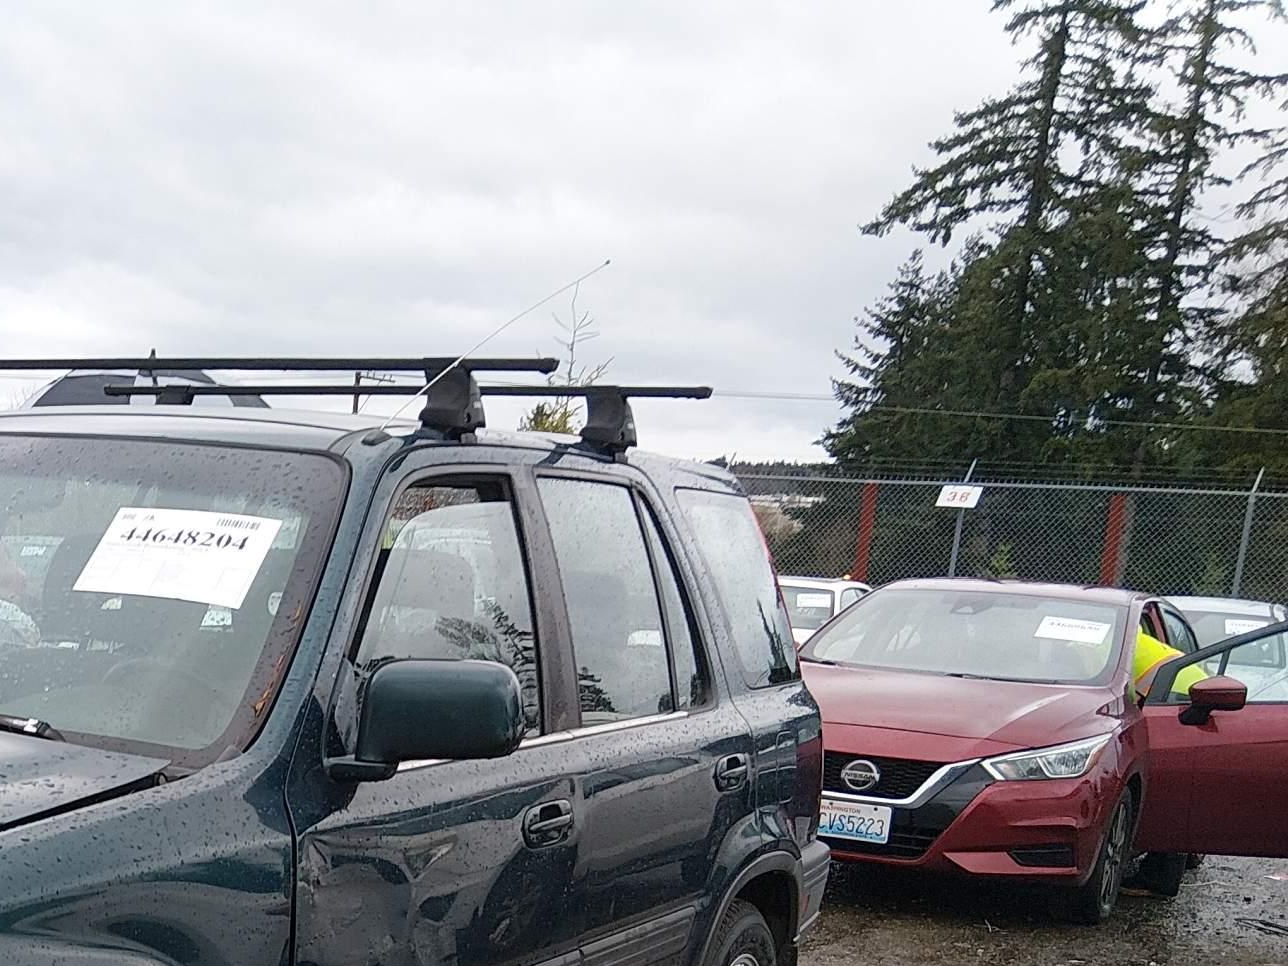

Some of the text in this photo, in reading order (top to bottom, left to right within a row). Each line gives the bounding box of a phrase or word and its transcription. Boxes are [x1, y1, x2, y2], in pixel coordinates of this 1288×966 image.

[120, 527, 249, 550] 44648204
[844, 771, 877, 780] NISSAN
[821, 804, 861, 814] WASHINGTON
